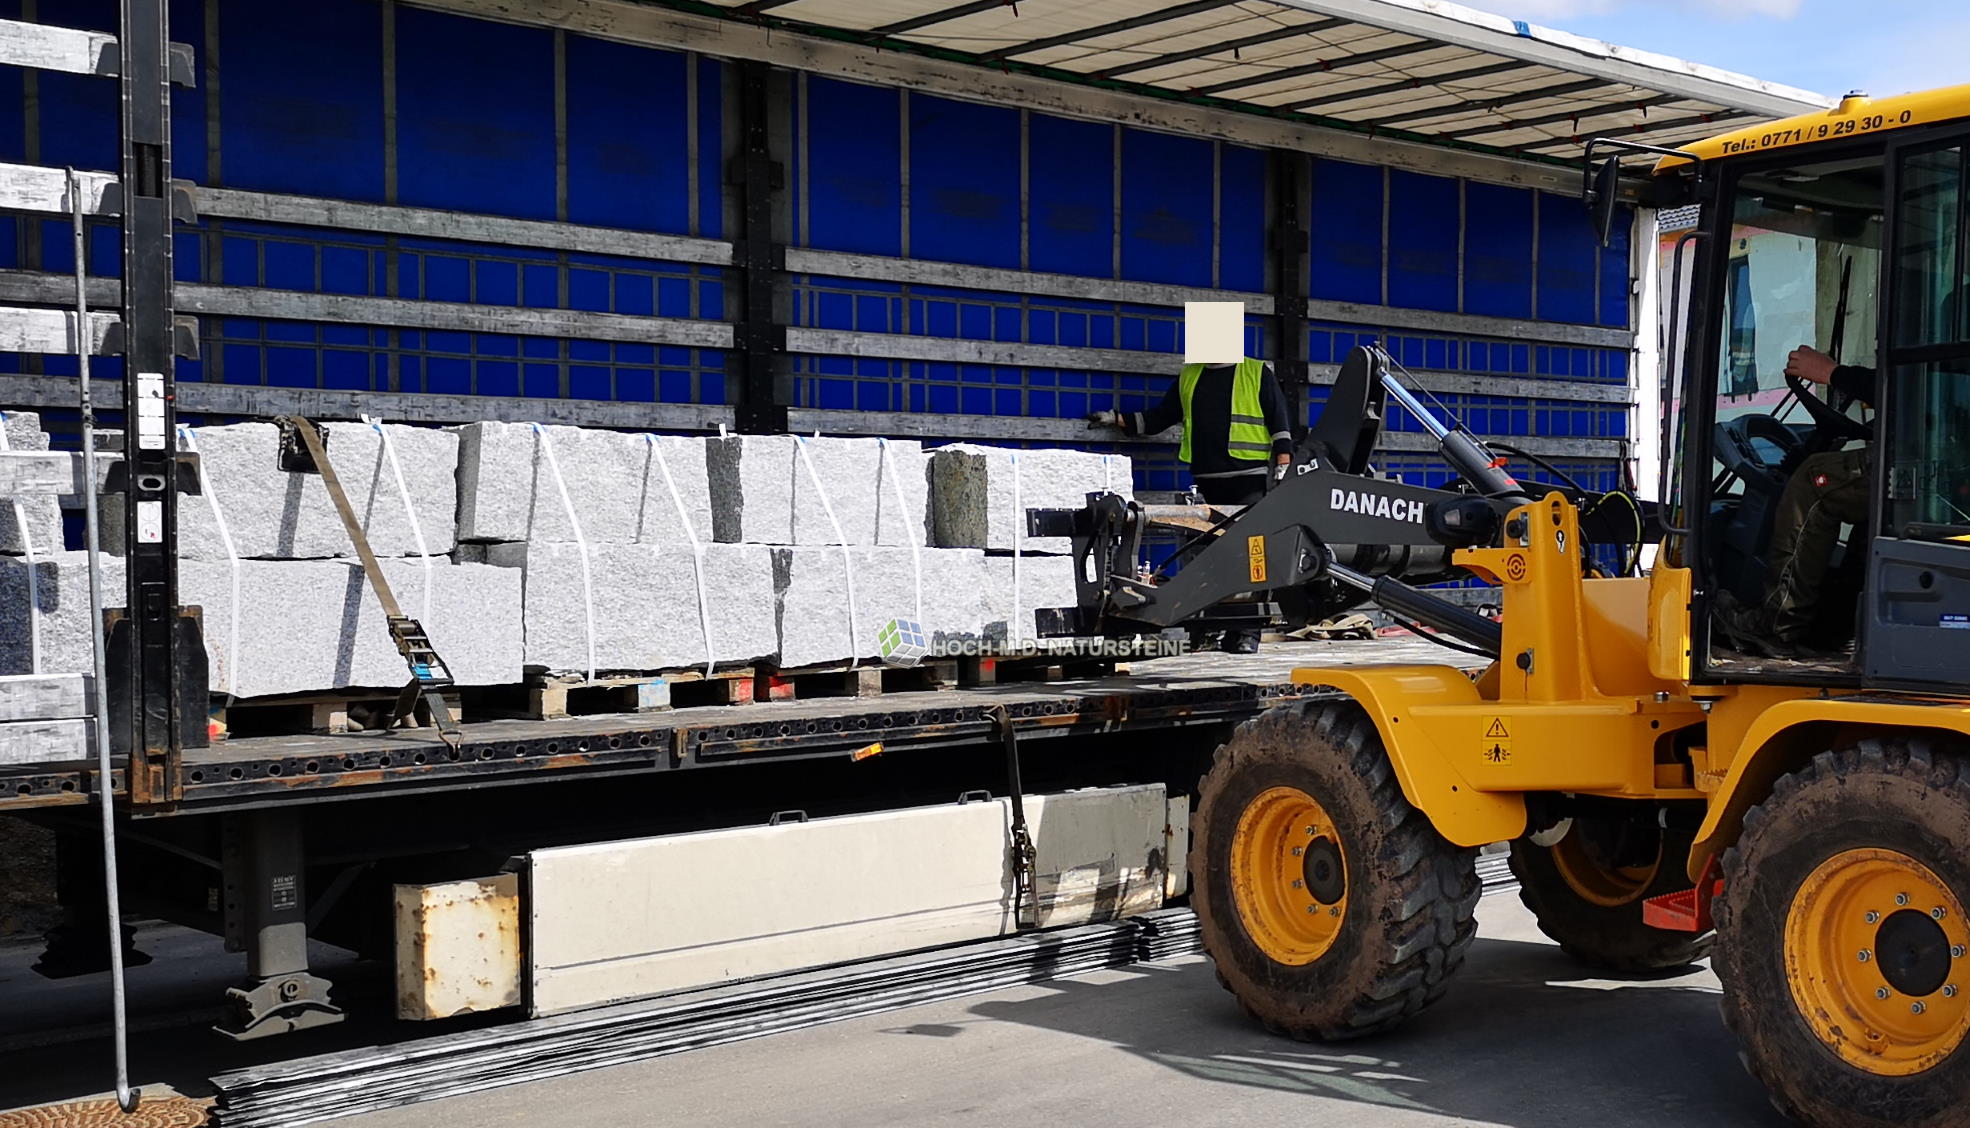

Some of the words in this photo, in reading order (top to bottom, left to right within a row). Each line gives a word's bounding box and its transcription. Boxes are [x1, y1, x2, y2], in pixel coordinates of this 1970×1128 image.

[1722, 139, 1756, 154] Tel.:
[1761, 128, 1802, 147] 0771
[1806, 126, 1814, 140] /
[1817, 124, 1828, 138] 9
[1833, 120, 1855, 135] 29
[1861, 115, 1883, 130] 30
[1899, 110, 1912, 123] 0
[1330, 488, 1424, 524] DANACH
